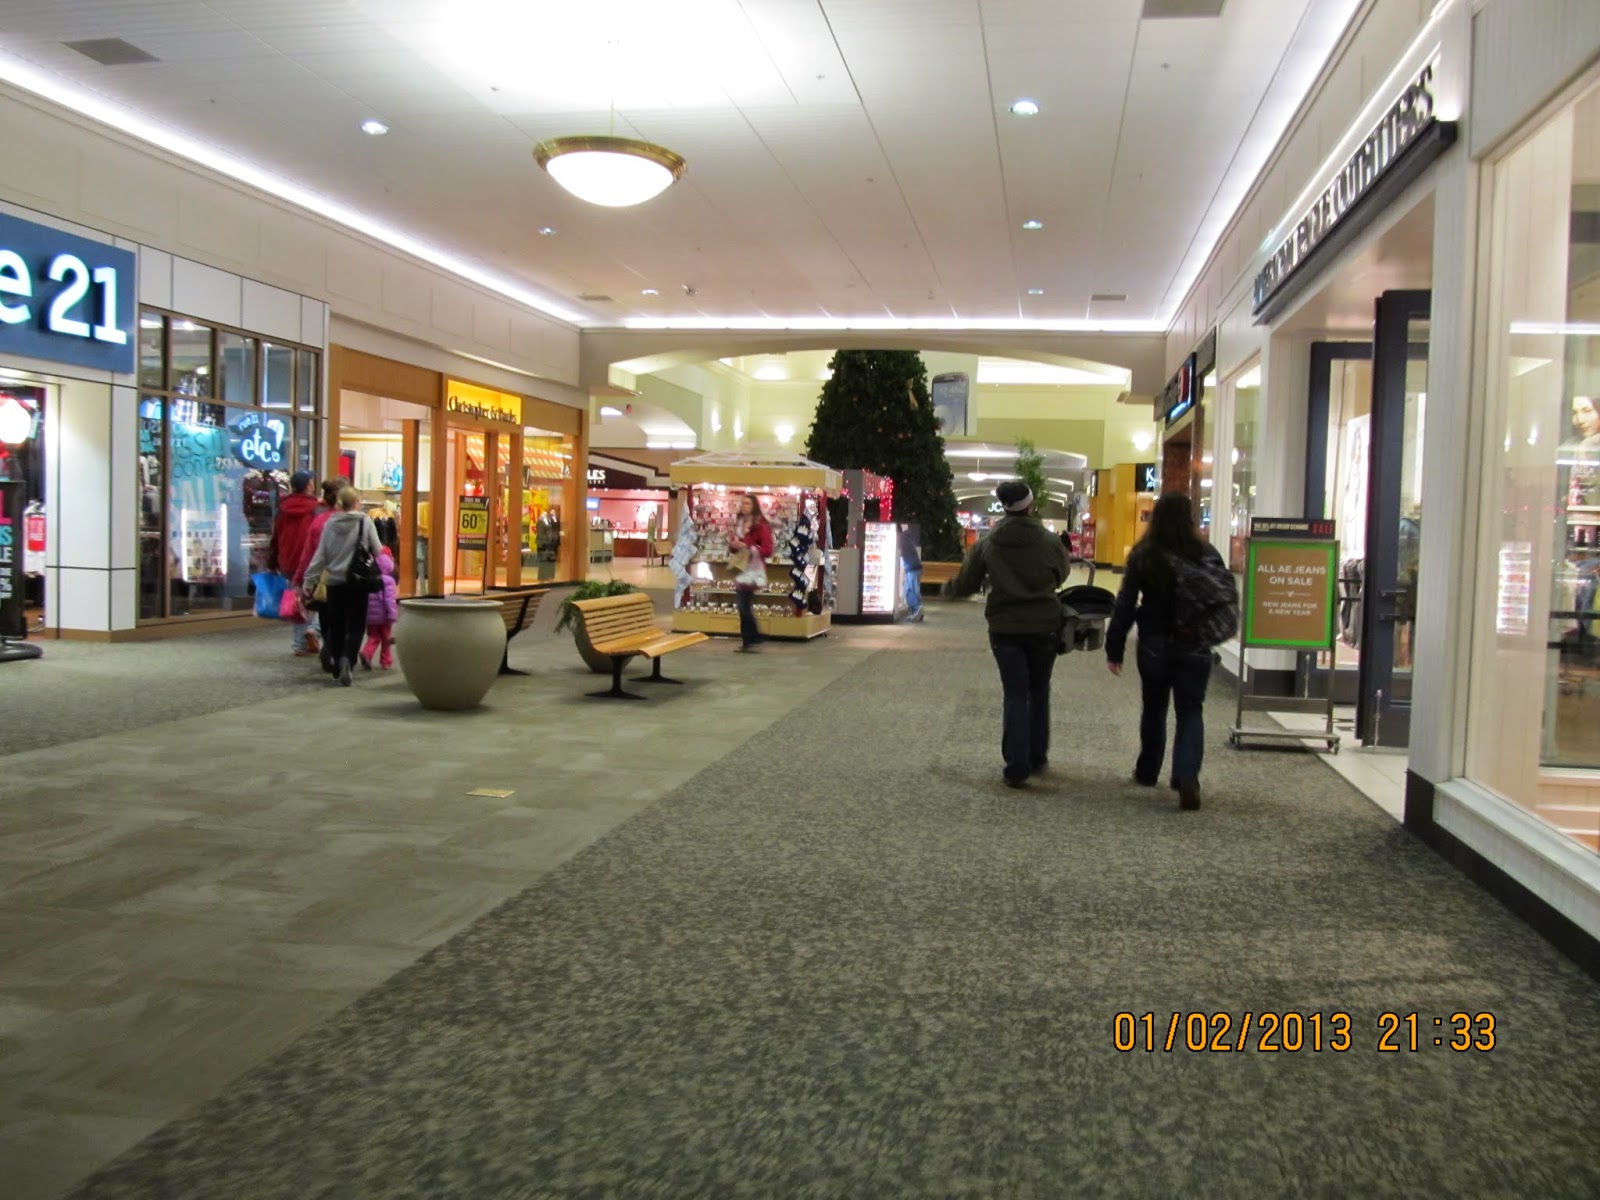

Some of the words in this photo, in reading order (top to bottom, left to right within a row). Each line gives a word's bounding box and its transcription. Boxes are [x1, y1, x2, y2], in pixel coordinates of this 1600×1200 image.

[49, 253, 127, 345] 21
[987, 501, 1004, 513] JC
[1257, 564, 1276, 573] ALL
[1278, 565, 1292, 573] AE
[1294, 565, 1326, 575] JEANS
[1269, 576, 1285, 585] ON
[1287, 577, 1313, 586] SALE
